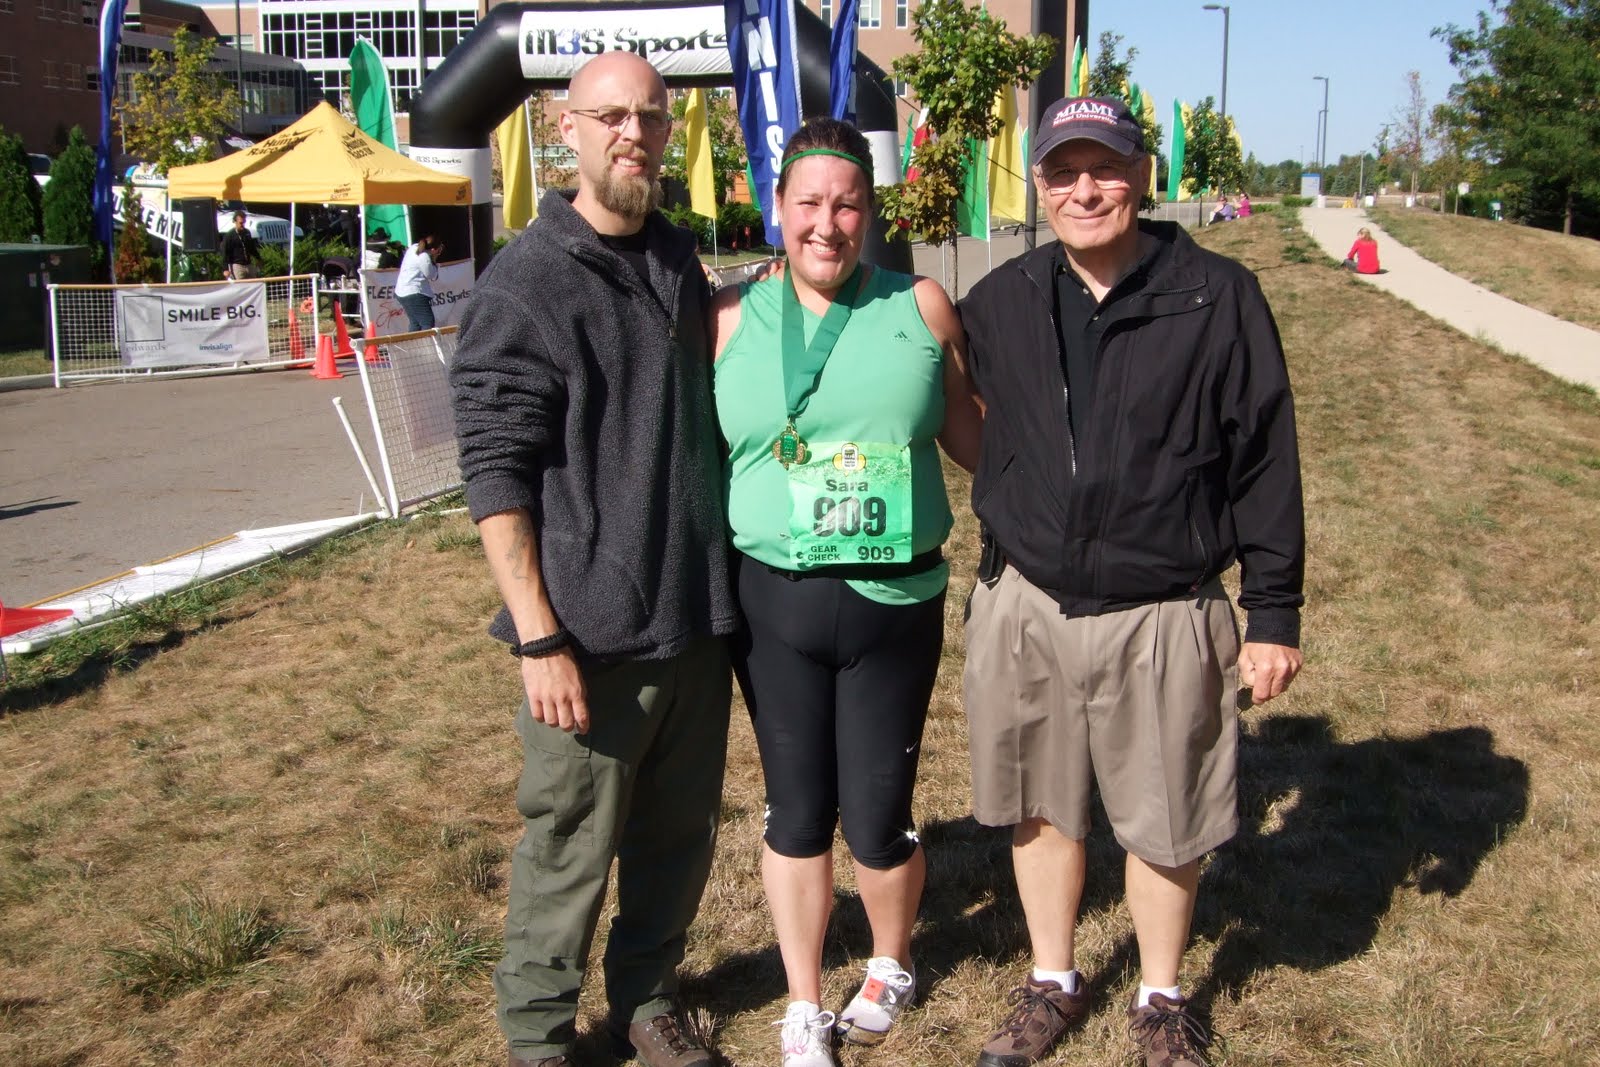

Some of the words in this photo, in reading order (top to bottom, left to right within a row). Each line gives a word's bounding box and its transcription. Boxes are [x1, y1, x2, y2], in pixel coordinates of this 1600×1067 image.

[742, 0, 784, 227] NIS
[1054, 101, 1118, 121] MIAMI
[367, 285, 396, 299] FLEE
[168, 307, 221, 323] SMILE
[226, 304, 262, 319] BIG.
[199, 343, 233, 351] invisalign
[826, 479, 868, 492] Sara
[813, 496, 886, 537] 909
[811, 545, 837, 553] GEAR
[857, 545, 895, 560] 909
[807, 553, 841, 561] CHECK
